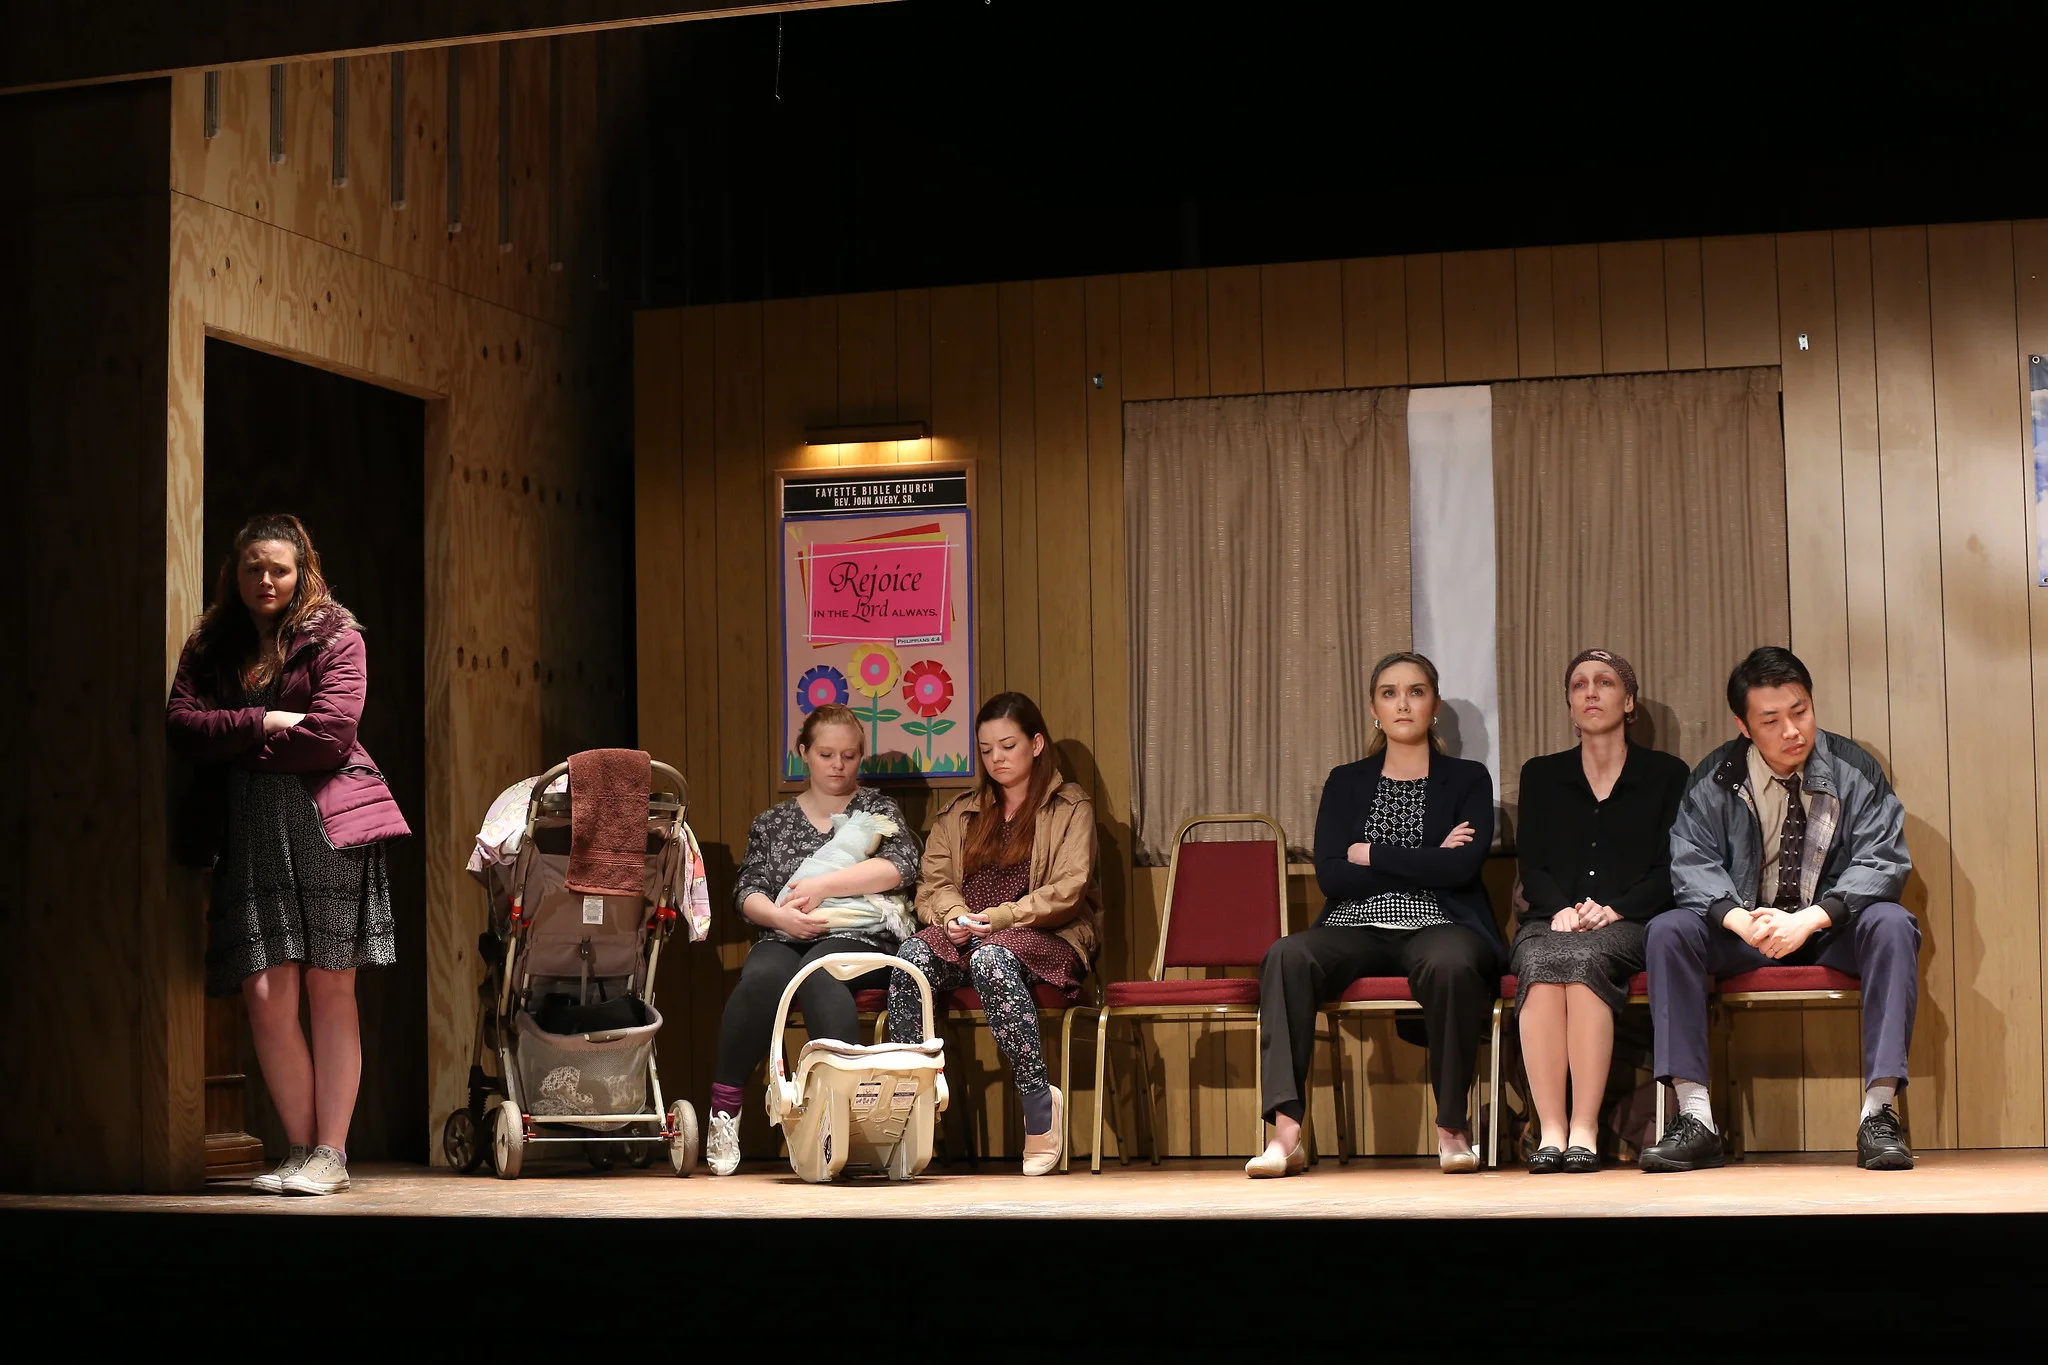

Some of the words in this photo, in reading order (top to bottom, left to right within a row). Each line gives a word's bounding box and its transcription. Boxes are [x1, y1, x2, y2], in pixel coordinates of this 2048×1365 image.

[815, 486, 857, 498] FAYETTE
[862, 484, 891, 496] BIBLE
[895, 483, 935, 494] CHURCH
[834, 497, 851, 507] REV.
[853, 496, 872, 506] JOHN
[874, 495, 900, 505] AVERY,
[902, 494, 915, 504] SR.
[828, 561, 923, 599] Rejoice
[814, 610, 825, 618] IN
[828, 609, 849, 618] THE
[852, 596, 889, 623] Lord
[892, 608, 938, 617] ALWAYS.
